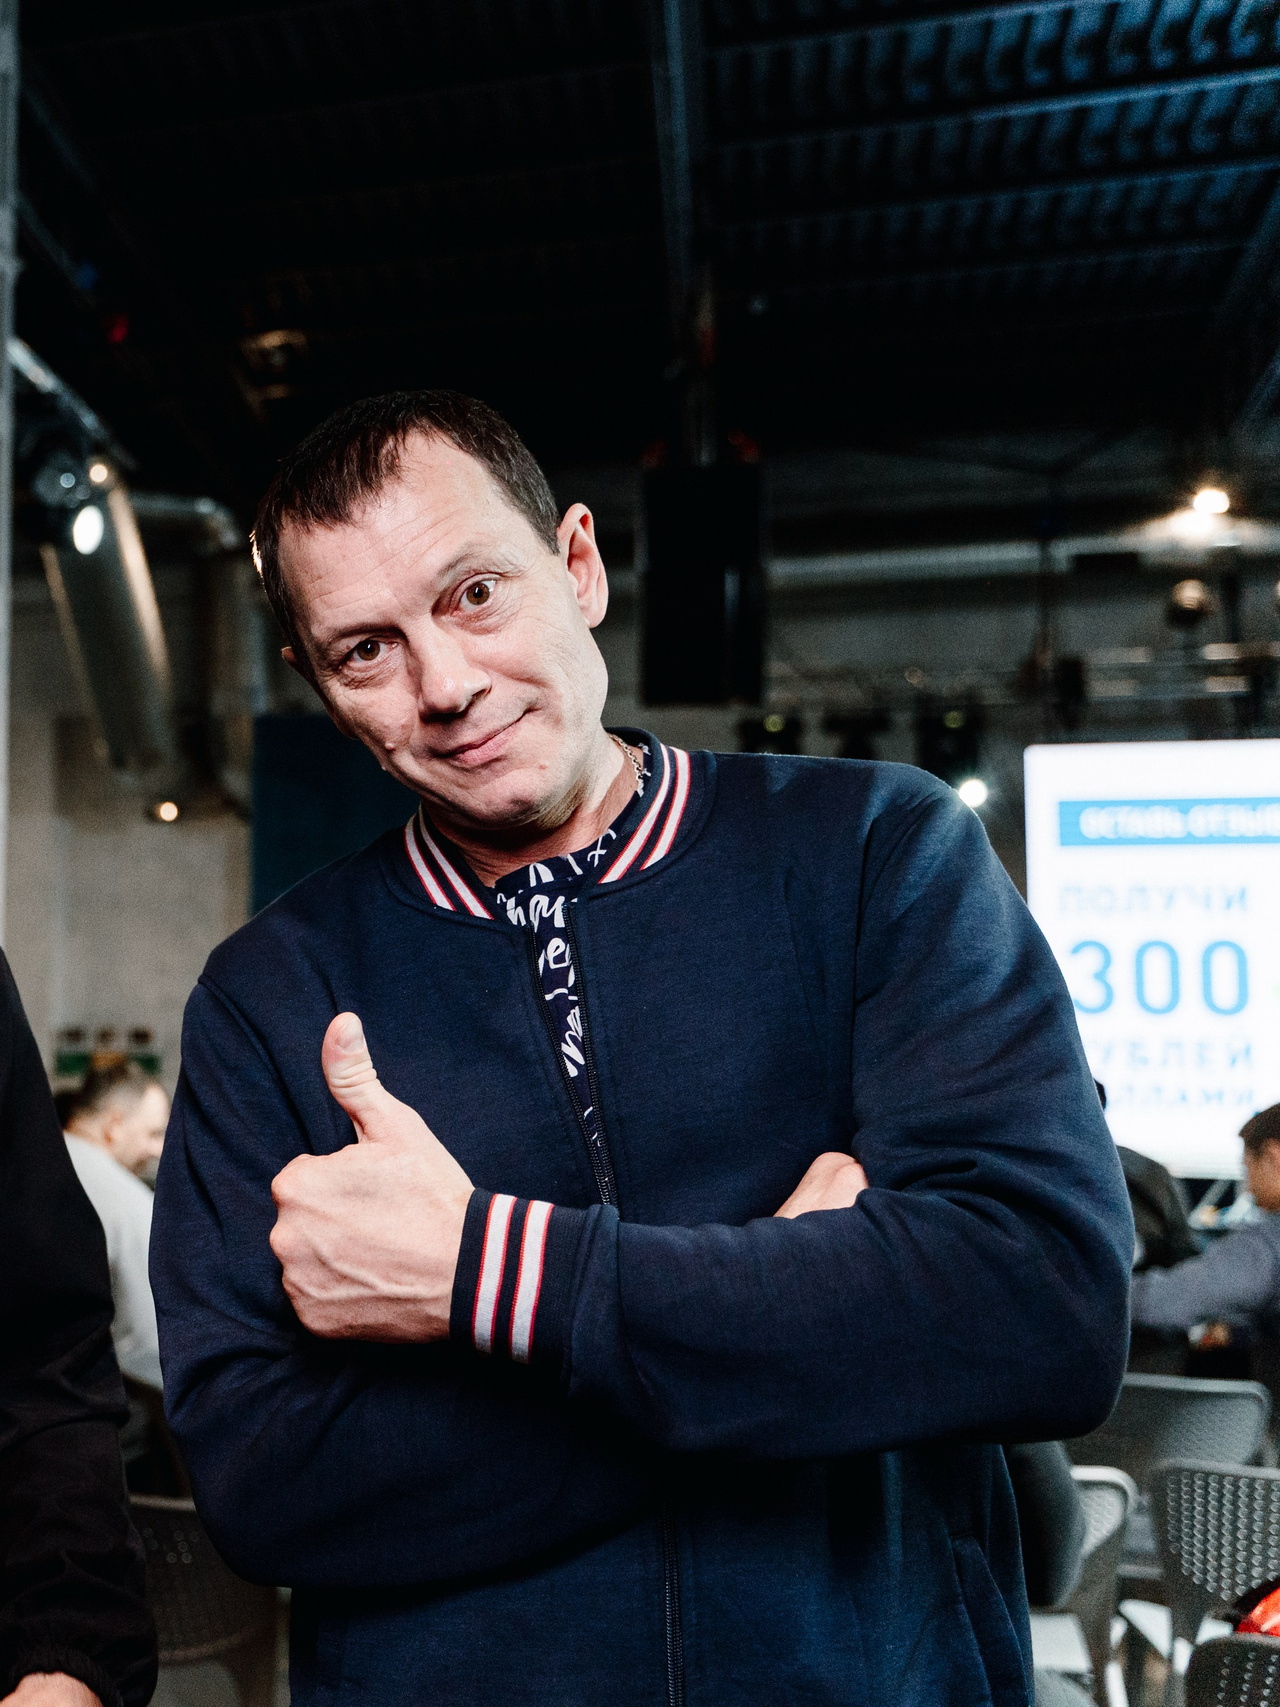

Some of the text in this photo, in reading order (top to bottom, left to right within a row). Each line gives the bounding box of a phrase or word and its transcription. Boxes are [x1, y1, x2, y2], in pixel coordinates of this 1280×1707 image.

[1058, 882, 1250, 915] ПОЛУЧИ
[1069, 940, 1250, 1016] 300
[1084, 1034, 1254, 1070] УБЛЕЙ
